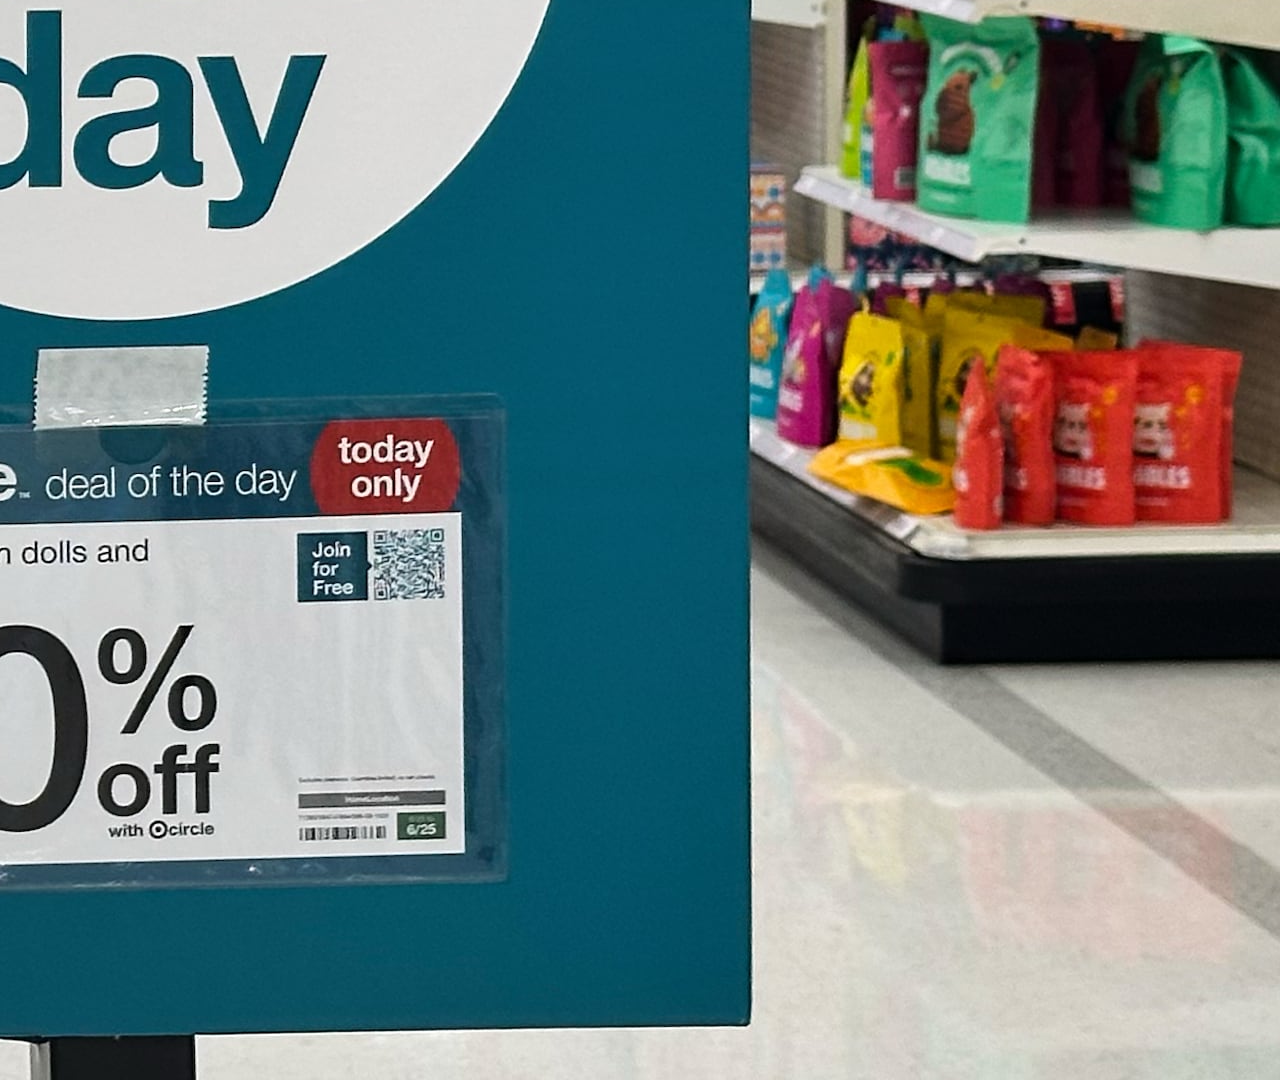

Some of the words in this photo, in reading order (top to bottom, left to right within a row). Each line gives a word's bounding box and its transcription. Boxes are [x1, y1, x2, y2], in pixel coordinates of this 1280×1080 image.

[338, 433, 435, 468] today
[45, 466, 116, 500] deal
[128, 465, 161, 498] of
[170, 464, 225, 497] the
[235, 463, 297, 501] day
[351, 469, 422, 503] only
[22, 539, 88, 565] dolls
[97, 538, 150, 564] and
[312, 541, 351, 559] Join
[312, 560, 339, 577] for
[312, 579, 354, 596] Free
[97, 743, 221, 817] off
[108, 822, 143, 838] with
[168, 820, 215, 838] circle
